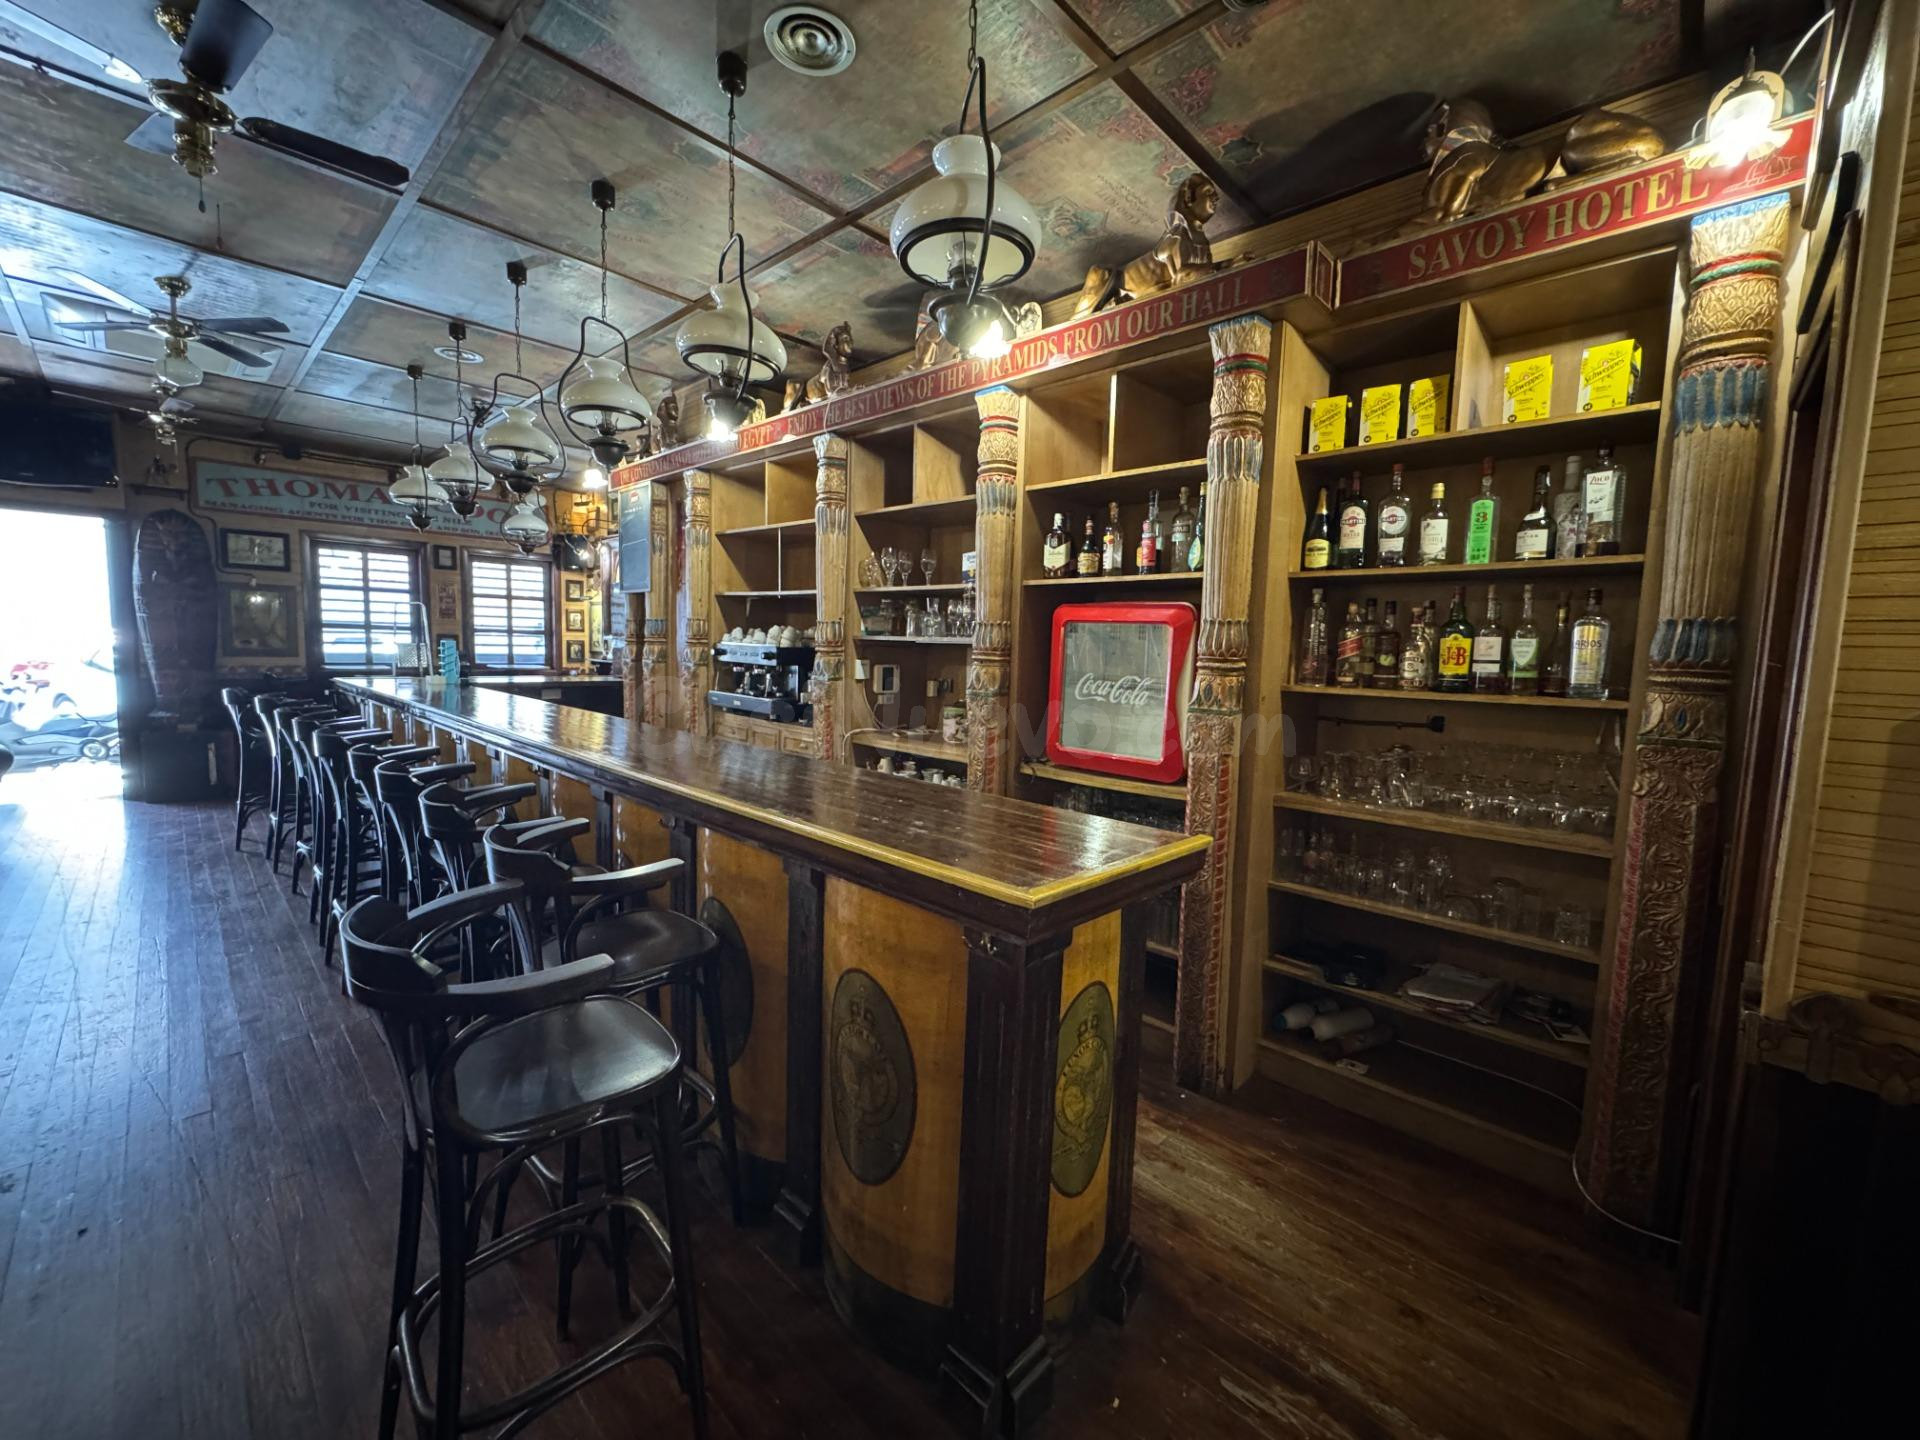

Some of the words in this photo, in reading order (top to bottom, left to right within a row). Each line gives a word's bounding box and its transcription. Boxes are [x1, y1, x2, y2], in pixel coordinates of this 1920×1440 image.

[1408, 211, 1536, 279] SAVOY
[1543, 165, 1710, 243] HOTEL
[787, 410, 818, 434] ENJOY
[844, 395, 871, 421] BEST
[874, 381, 914, 412] VIEWS
[917, 374, 936, 400] OF
[939, 363, 967, 393] THE
[971, 335, 1058, 385] PYRAMIDS
[1063, 315, 1120, 358] FROM
[1127, 300, 1173, 338] OUR
[1180, 277, 1249, 323] HALL
[1584, 359, 1625, 383] Schweppes
[743, 425, 771, 449] EGYPT
[206, 477, 390, 504] THOMA
[1441, 646, 1467, 666] J&B
[1075, 672, 1154, 705] Coca-Cola
